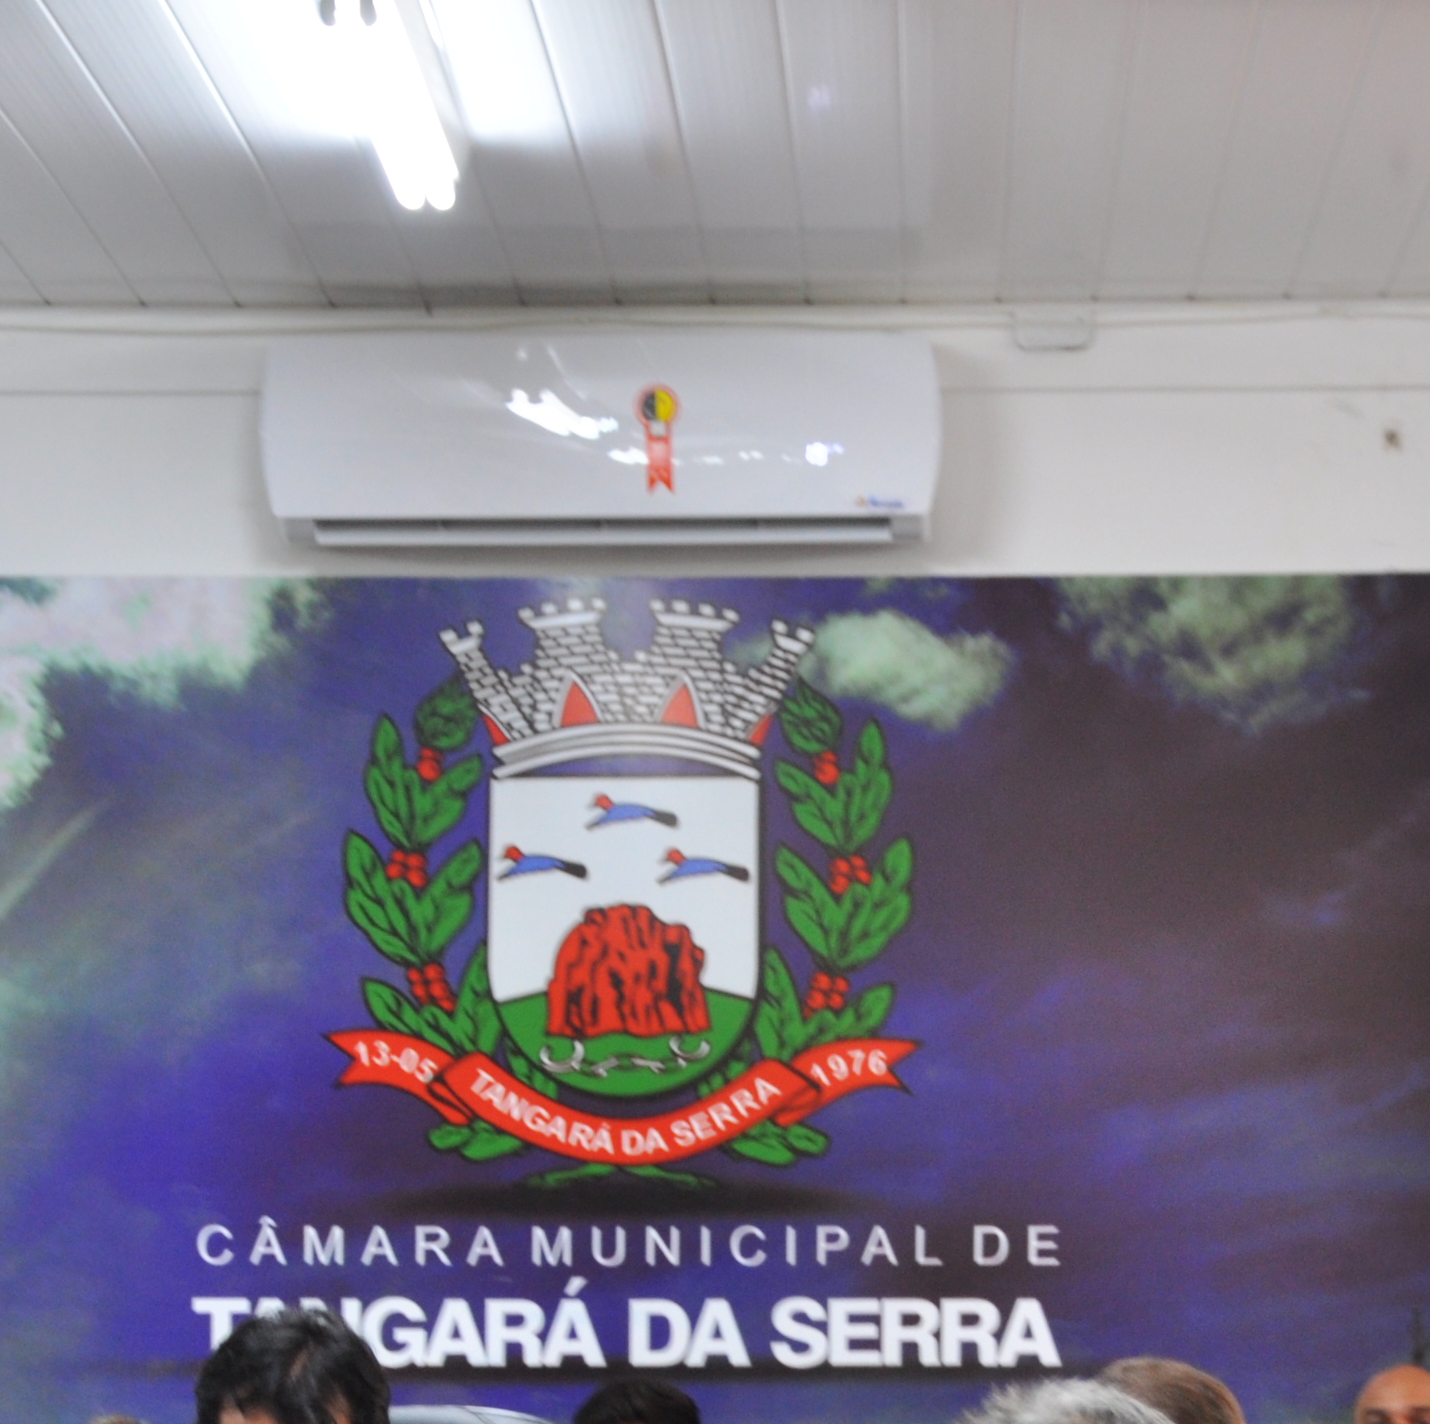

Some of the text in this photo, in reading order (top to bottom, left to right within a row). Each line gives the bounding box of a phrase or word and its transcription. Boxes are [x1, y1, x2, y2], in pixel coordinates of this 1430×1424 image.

[355, 1039, 440, 1083] 13-05
[810, 1049, 888, 1086] 1976
[470, 1067, 782, 1156] TANGARÁ DA SERRA
[196, 1215, 1061, 1268] CÂMARA MUNICIPAL DE
[191, 1276, 1062, 1370] TGARÁ DA SERRA
